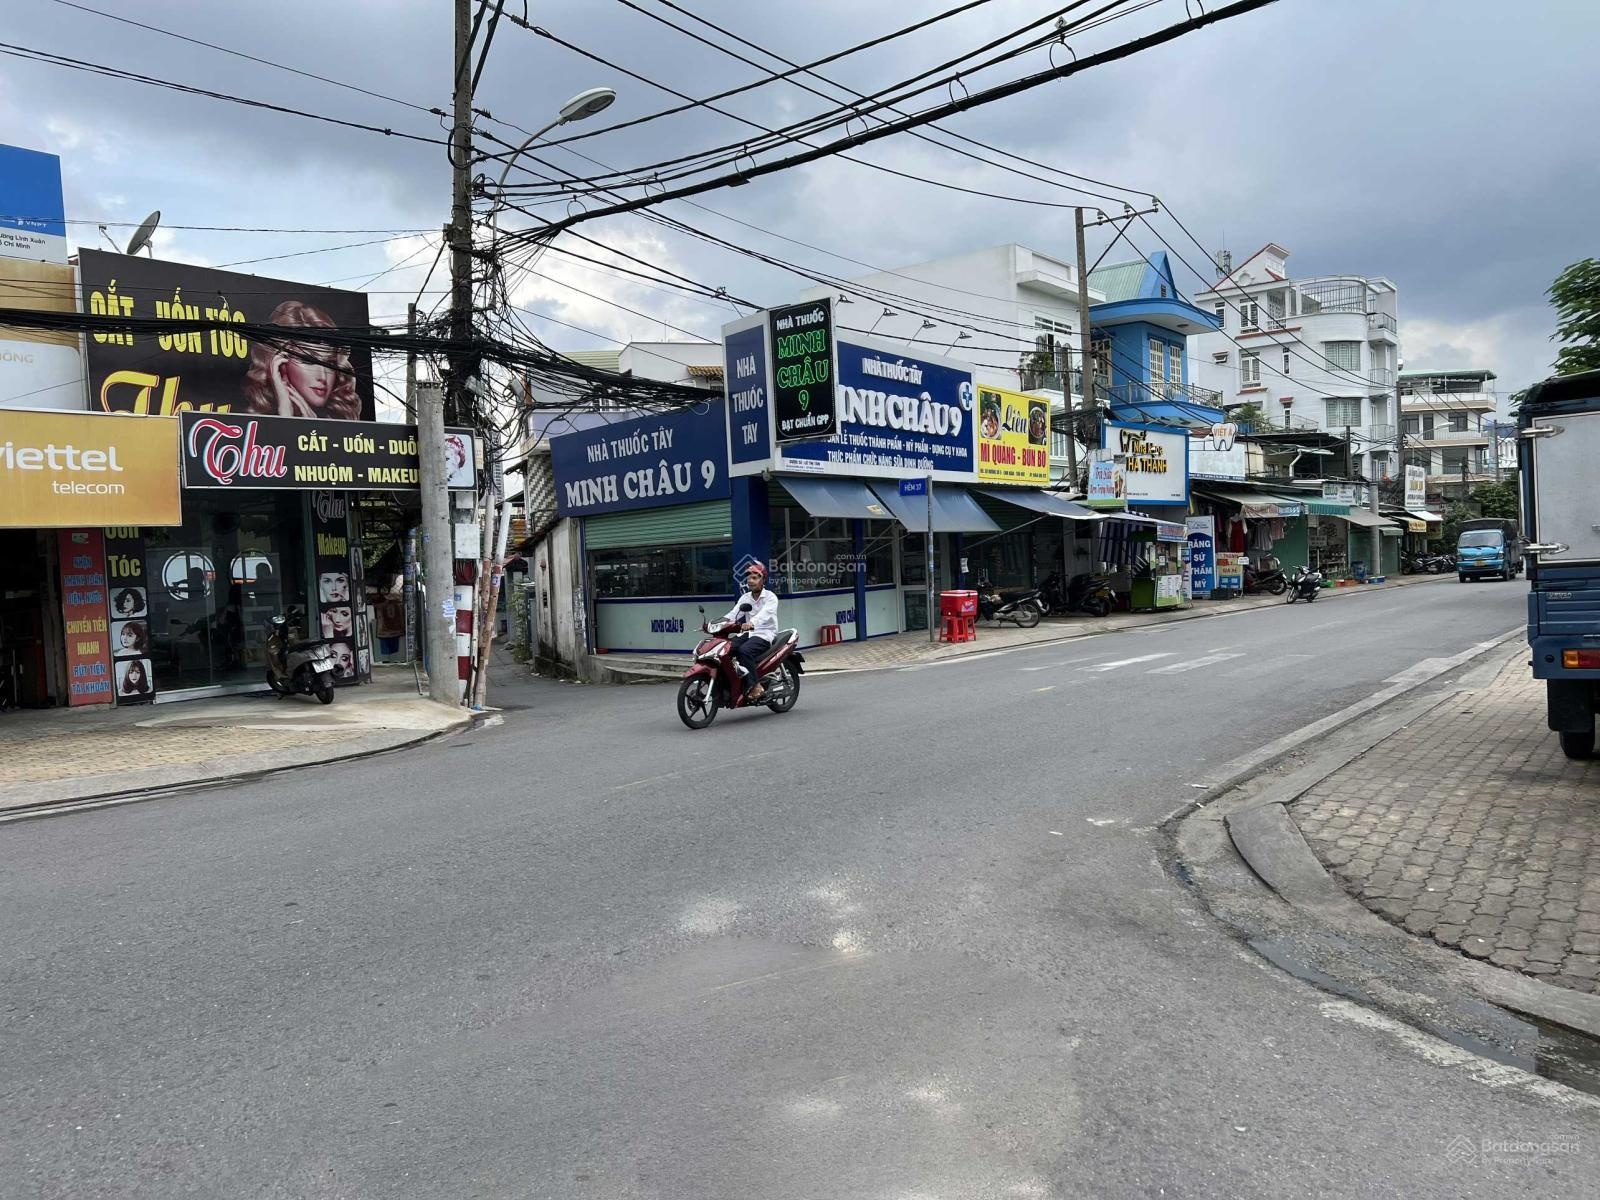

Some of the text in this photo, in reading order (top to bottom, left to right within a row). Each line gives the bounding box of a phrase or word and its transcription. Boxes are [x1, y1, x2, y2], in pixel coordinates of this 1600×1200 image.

[16, 242, 31, 250] Minh
[776, 308, 825, 331] NHÀ THUỐC
[777, 328, 826, 359] MINH
[736, 352, 757, 379] NHÀ
[777, 356, 829, 389] CHÂU
[862, 356, 923, 385] NHÀ THUỐC TÂY
[732, 384, 764, 414] THUỐC
[798, 389, 810, 411] 9
[838, 384, 963, 437] INH CHÂU 9
[297, 430, 420, 456] CẮT UỐN DUỖ
[587, 425, 674, 464] NHÀ THUỐC TÂY
[742, 421, 758, 445] TÂY
[848, 431, 868, 447] THUỐC
[0, 441, 124, 472] iettel
[189, 418, 288, 485] Thu
[991, 441, 1016, 465] QUẢNG
[1021, 446, 1036, 467] BÚN
[52, 480, 125, 495] telecom
[294, 463, 421, 486] NHUỘM MAKEU
[564, 459, 716, 508] MINH CHÂU 9
[317, 533, 347, 558] Makeup
[679, 618, 684, 633] 9
